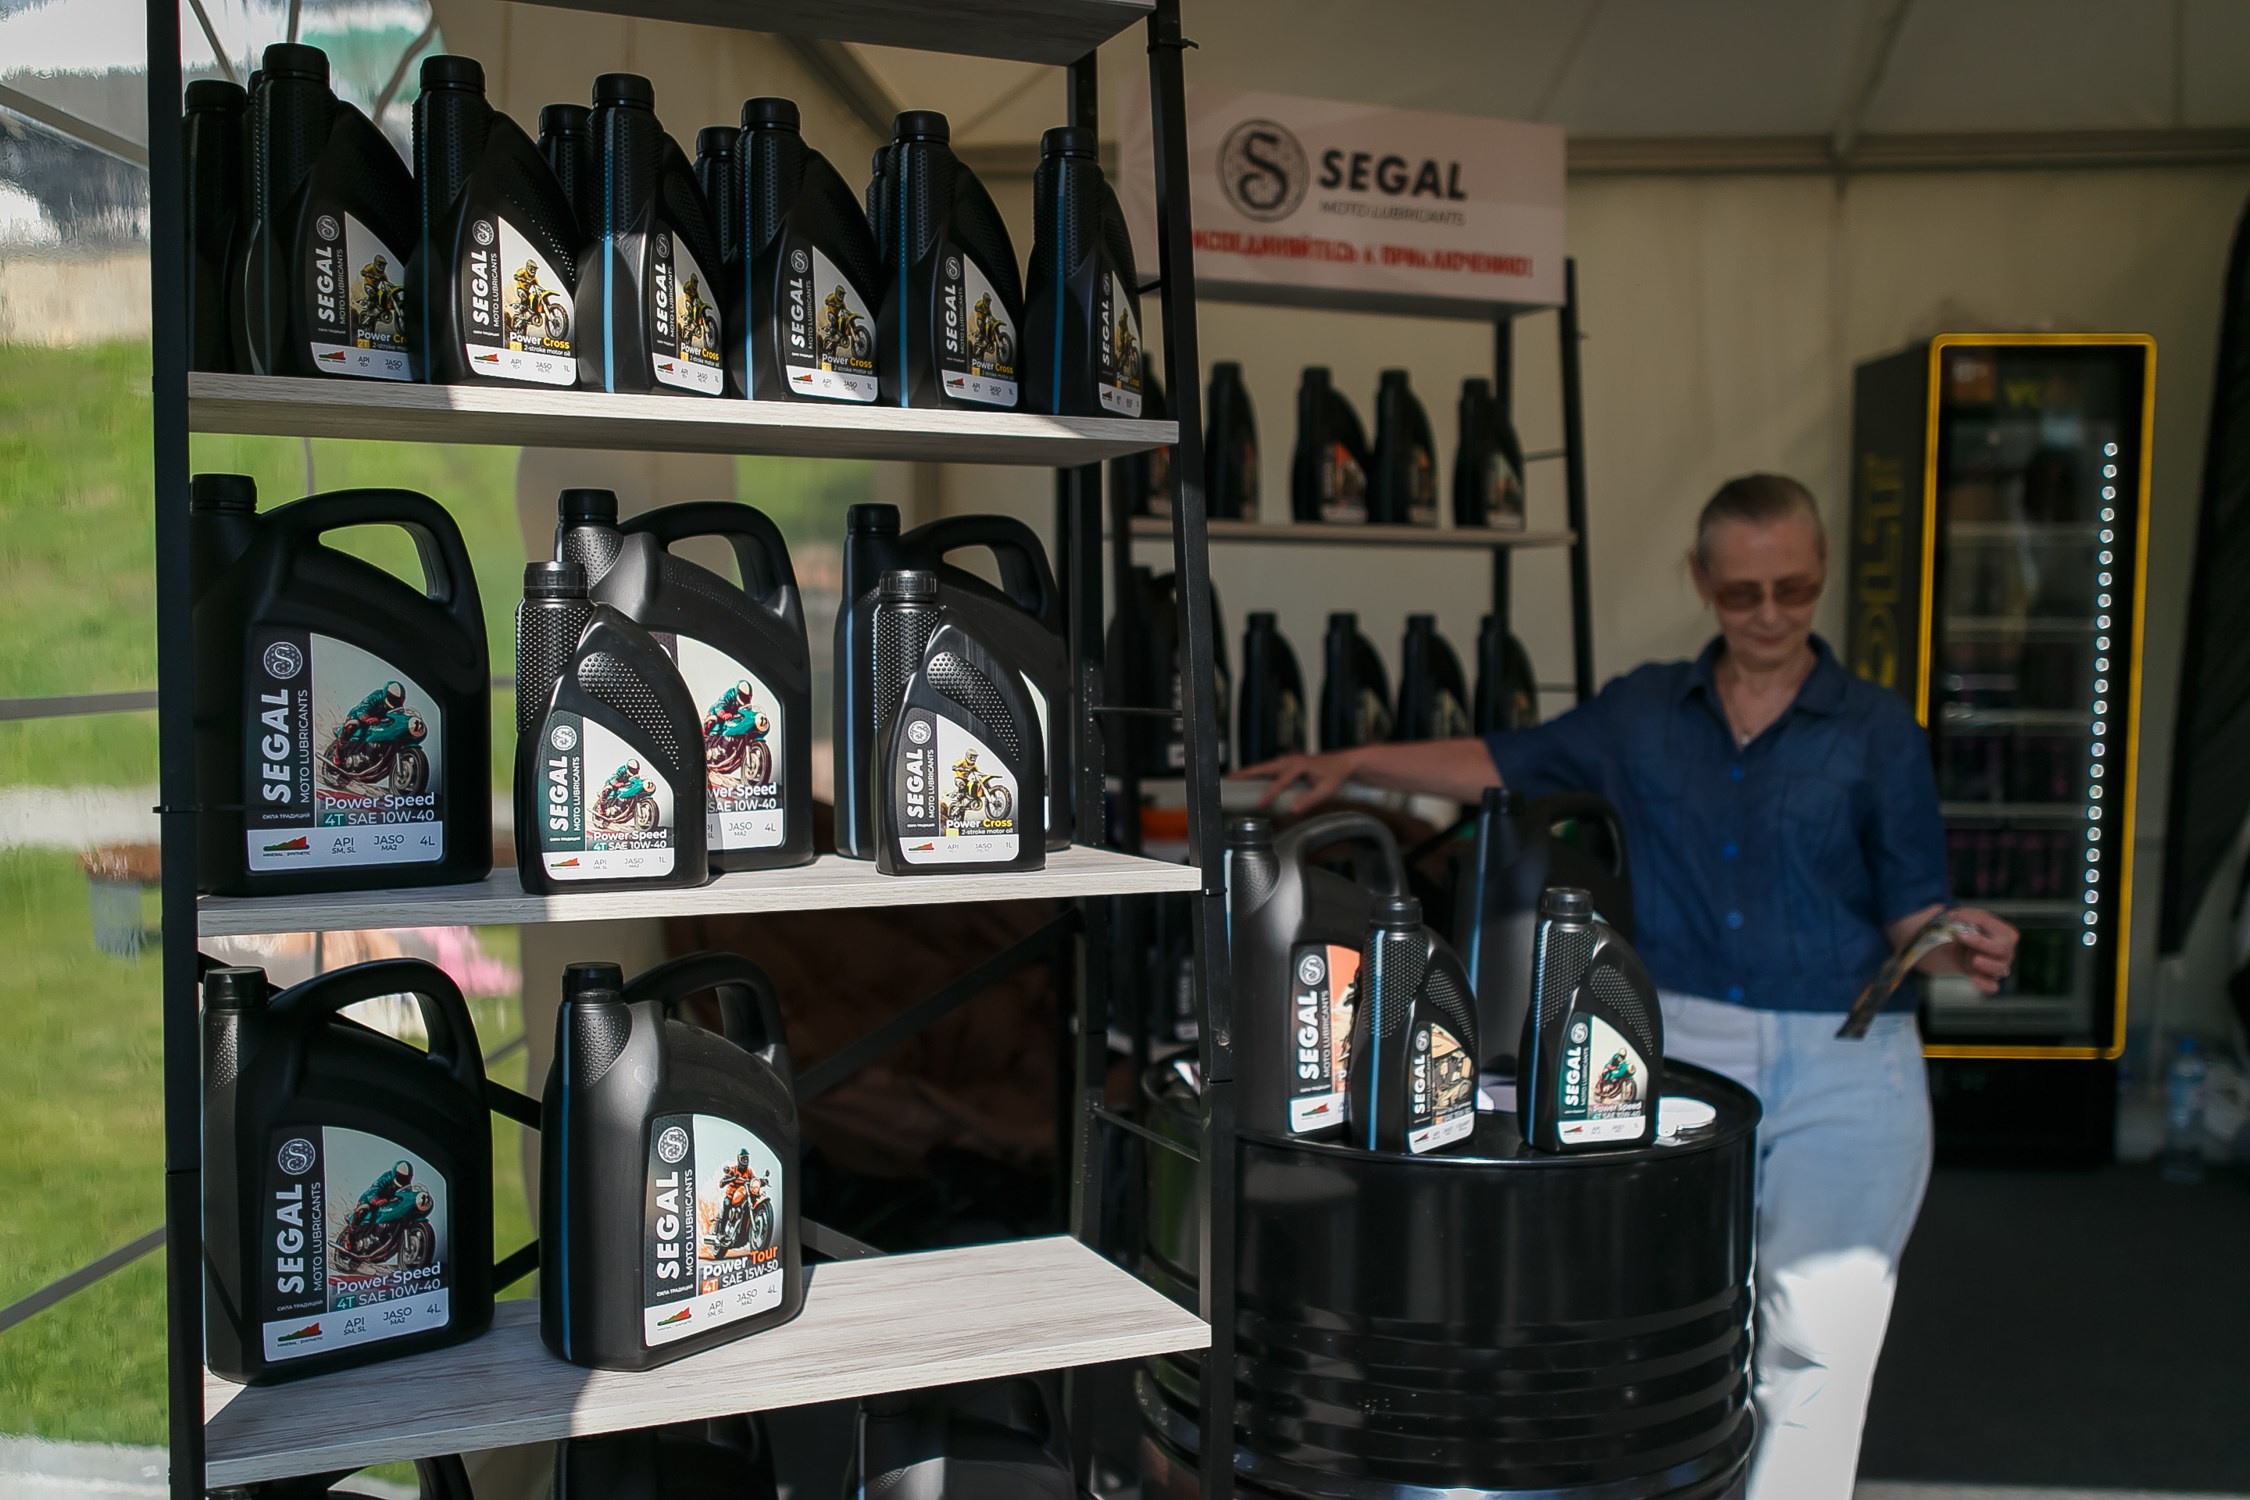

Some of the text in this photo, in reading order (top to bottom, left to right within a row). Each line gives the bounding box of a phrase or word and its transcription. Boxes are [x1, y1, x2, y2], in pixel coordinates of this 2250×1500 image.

[1319, 149, 1467, 201] SEGAL
[1321, 199, 1371, 218] MOTO
[316, 247, 335, 322] SEGAL
[337, 249, 345, 298] LUBRICANTS
[471, 250, 489, 325] SEGAL
[490, 253, 499, 303] LUBRICANTS
[655, 263, 668, 335] SEGAL
[790, 278, 805, 348] SEGAL
[945, 284, 957, 352] SEGAL
[1102, 300, 1110, 366] SEGAL
[357, 329, 390, 341] Power
[510, 332, 542, 345] Power
[543, 337, 570, 349] Cross
[385, 359, 402, 367] JASO
[681, 342, 701, 355] Power
[702, 347, 719, 360] Cross
[822, 354, 848, 364] Power
[850, 358, 872, 368] Cross
[972, 358, 994, 370] Power
[995, 363, 1013, 374] Cross
[844, 381, 857, 389] JASO
[261, 689, 291, 804] SEGAL
[298, 689, 310, 803] MOTO LUBRICANTS
[572, 756, 580, 805] LUBRICANTS
[906, 748, 924, 818] SEGAL
[927, 749, 935, 795] LUBRICANTS
[325, 792, 434, 809] Power Speed
[549, 756, 569, 831] SEGAL
[708, 798, 777, 812] SAE 10W-40
[736, 782, 777, 799] Speed
[325, 810, 434, 826] 4T SAE 10W-40
[729, 821, 753, 831] JASO
[764, 823, 776, 831] 4L
[946, 818, 1012, 828] Power Cross
[334, 837, 354, 847] API
[374, 835, 405, 845] JASO
[420, 836, 435, 845] 4L
[593, 831, 629, 840] Power
[632, 829, 667, 841] Speed
[608, 842, 628, 850] SAE
[630, 841, 667, 849] 10W-40
[1297, 990, 1320, 1080] SEGAL
[1321, 990, 1331, 1078] MOTO LUBRICANTS
[1414, 1054, 1426, 1114] SEGAL
[1565, 1046, 1581, 1106] SEGAL
[311, 1182, 322, 1292] MOTO LUBRICANTS
[656, 1171, 680, 1280] SEGAL
[685, 1168, 694, 1276] MOTO LUBRICANTS
[276, 1184, 305, 1294] SEGAL
[337, 1261, 441, 1295] Power Speed
[702, 1246, 778, 1279] Power Tour
[703, 1259, 778, 1292] 4T SAE 15W-50
[337, 1278, 440, 1309] 4T SAE 10W-40
[736, 1289, 758, 1302] JASO
[767, 1285, 777, 1294] 4L
[383, 1307, 413, 1321] JASO
[427, 1304, 441, 1314] 4L
[709, 1300, 724, 1311] API
[345, 1317, 365, 1329] API
